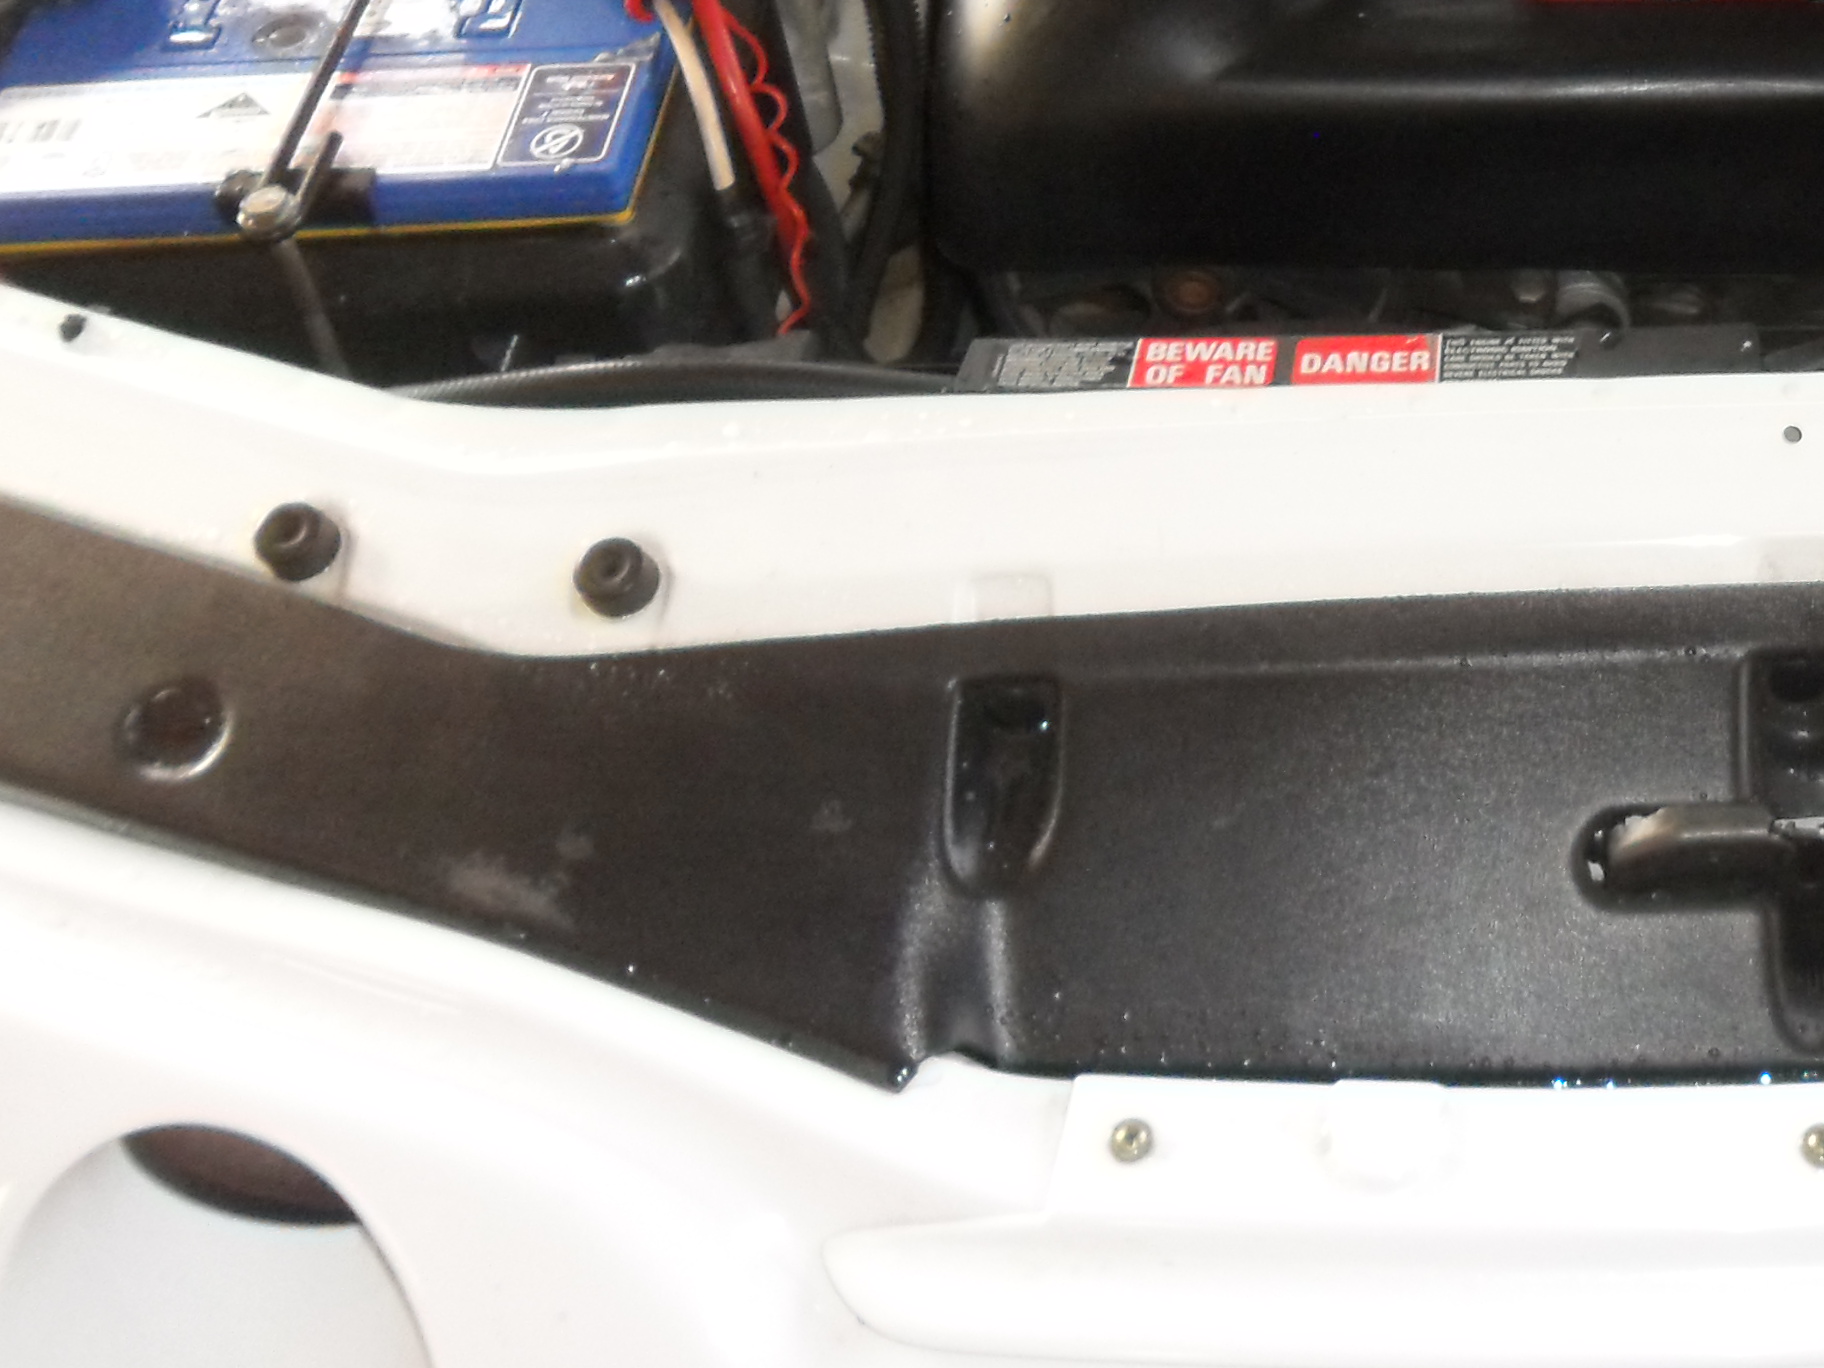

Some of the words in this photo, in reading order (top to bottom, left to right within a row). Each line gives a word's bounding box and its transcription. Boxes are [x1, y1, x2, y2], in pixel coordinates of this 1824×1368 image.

[1145, 340, 1275, 363] BEWARE
[1300, 350, 1431, 375] DANGER
[1145, 364, 1185, 386] OF
[1204, 364, 1268, 385] FAN
